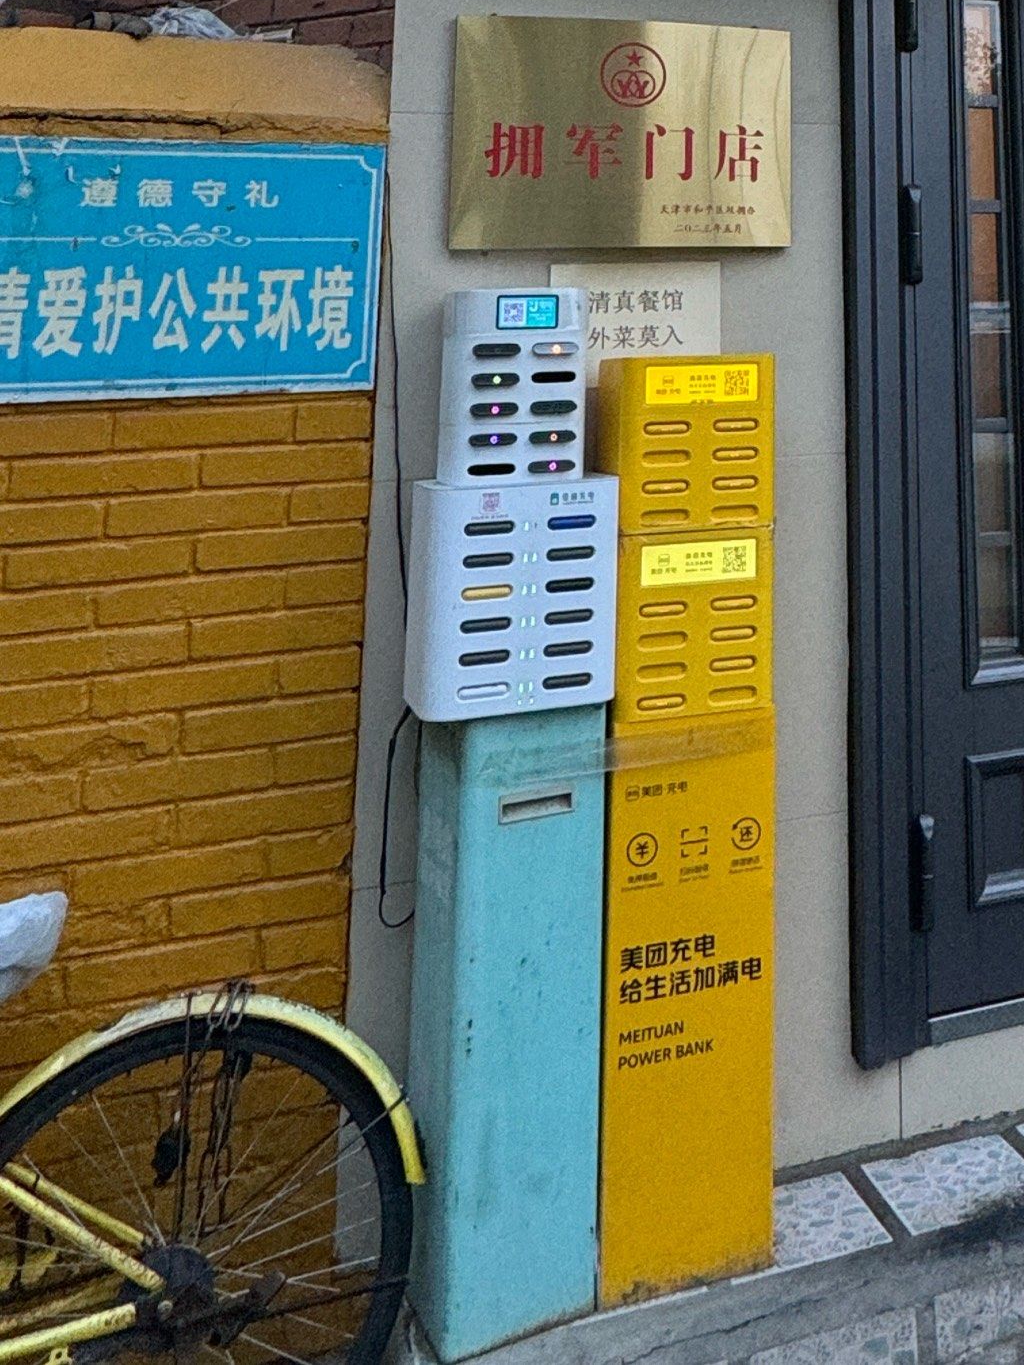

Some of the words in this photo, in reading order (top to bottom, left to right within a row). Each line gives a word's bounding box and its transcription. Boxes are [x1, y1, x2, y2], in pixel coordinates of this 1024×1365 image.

[484, 122, 765, 183] 拥军门店
[80, 178, 280, 209] 遵德守礼
[588, 289, 684, 314] 清真餐馆
[588, 324, 684, 349] 外菜莫入
[620, 934, 715, 974] 美团充电
[619, 957, 762, 1004] 给生活加满电
[619, 1021, 684, 1046] MEITUAN
[618, 1047, 671, 1070] POWER
[675, 1039, 714, 1059] BANK
